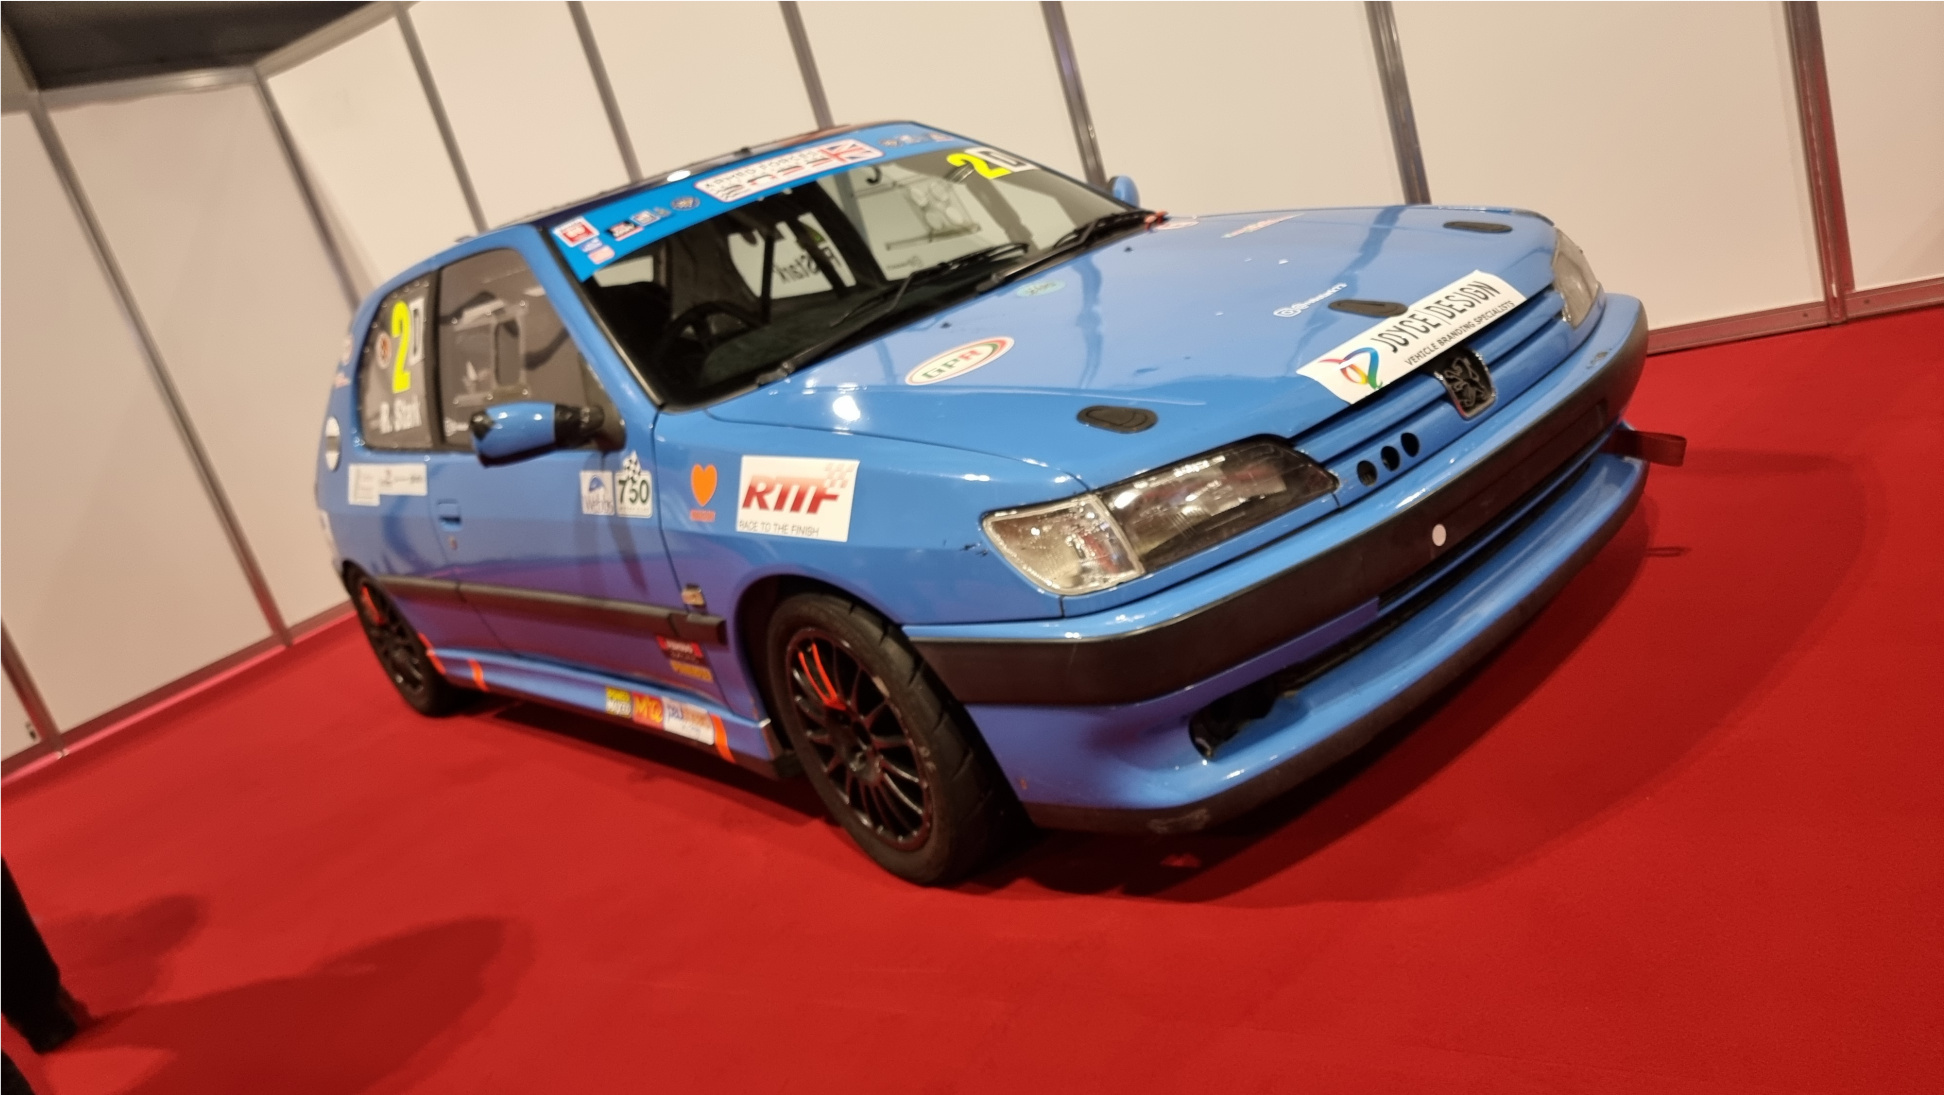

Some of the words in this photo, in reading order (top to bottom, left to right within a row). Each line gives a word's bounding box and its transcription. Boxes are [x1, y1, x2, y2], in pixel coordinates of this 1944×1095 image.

[946, 153, 1013, 180] 2
[1370, 312, 1442, 354] JOYCE
[1424, 280, 1501, 320] DESIGN
[391, 301, 412, 394] 2
[1404, 341, 1439, 366] VEHICLE
[1437, 320, 1476, 348] BRANDING
[1474, 299, 1516, 325] SPECIALISTS
[922, 350, 983, 380] GPR
[618, 479, 650, 505] 750
[739, 520, 758, 532] RACE
[761, 522, 772, 533] TO
[773, 522, 789, 535] THE
[791, 525, 820, 537] FINISH
